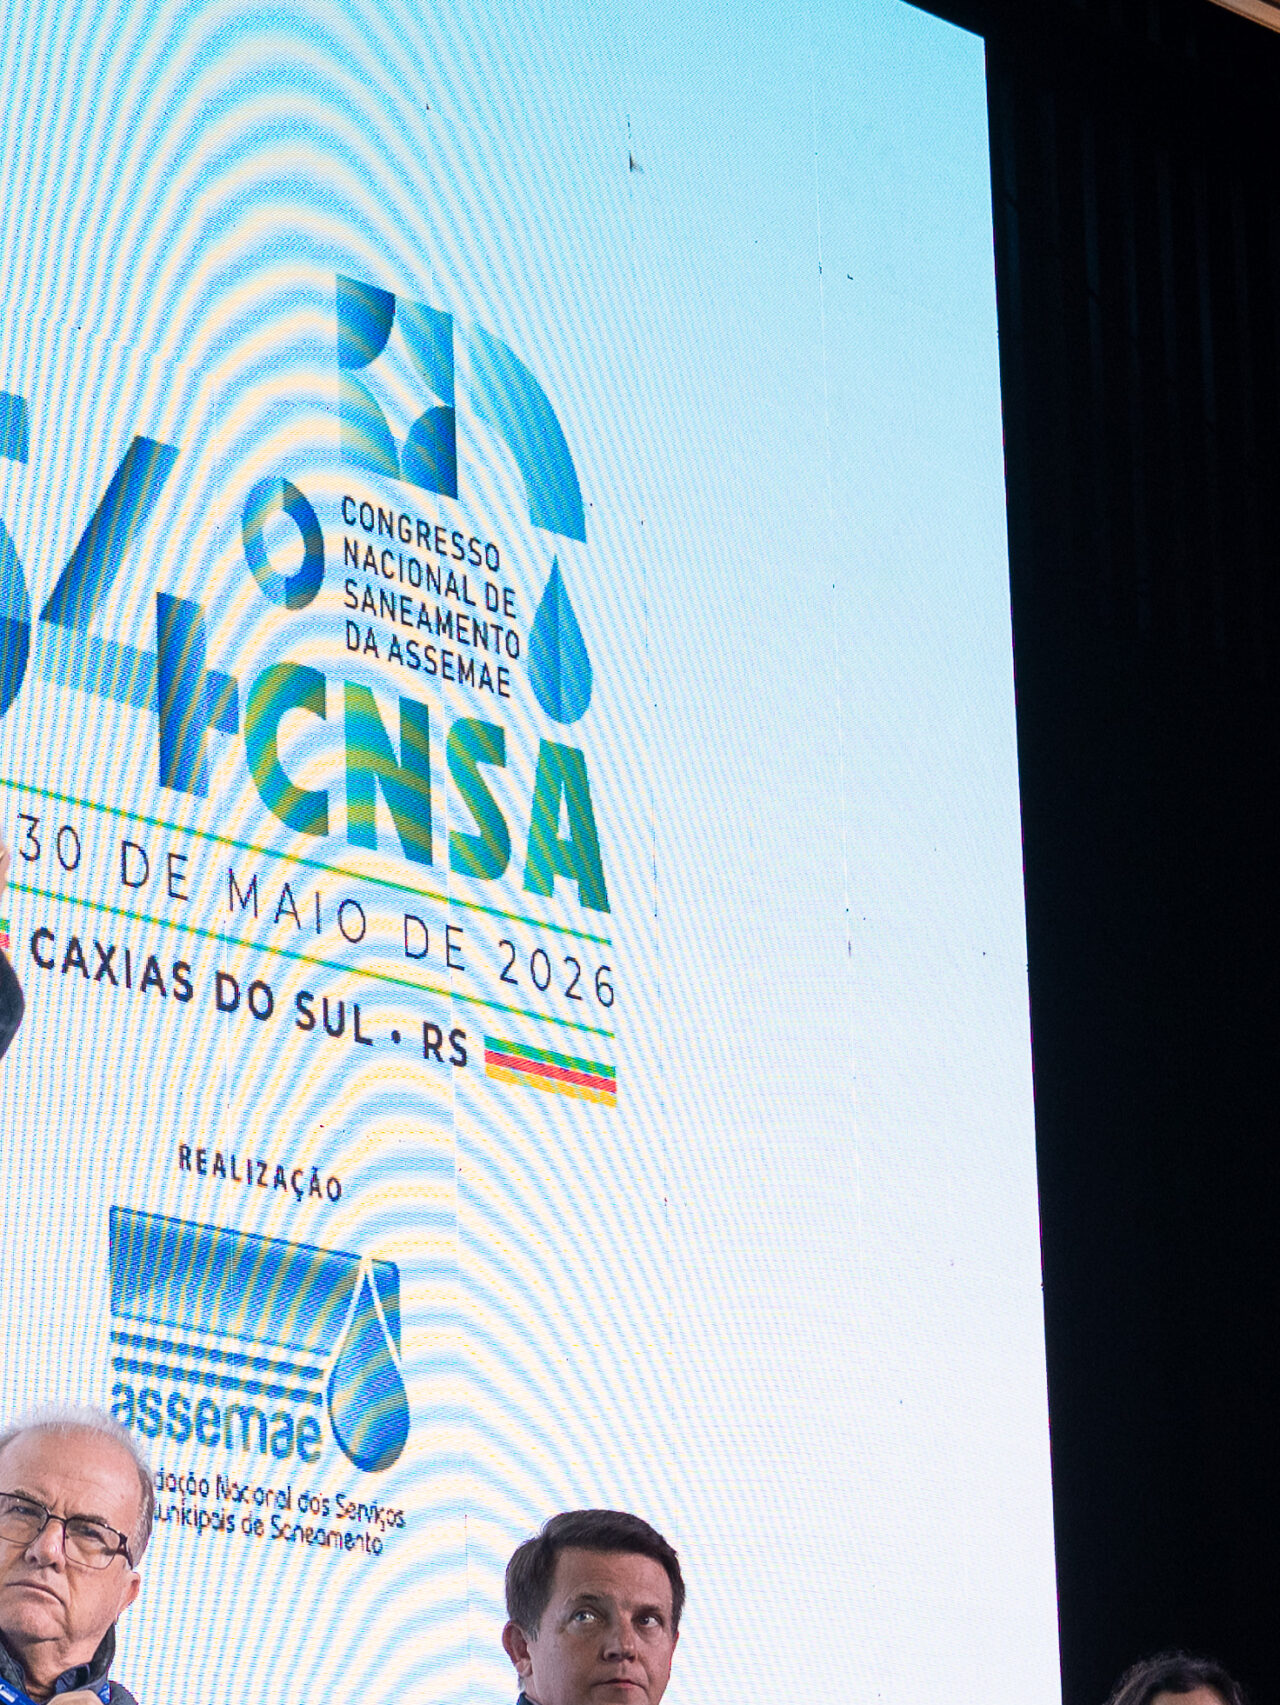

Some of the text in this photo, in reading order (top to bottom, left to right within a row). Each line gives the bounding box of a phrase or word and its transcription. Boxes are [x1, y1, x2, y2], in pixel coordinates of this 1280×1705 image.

[342, 495, 500, 573] CONGRESSO
[344, 536, 517, 619] NACIONAL DE
[344, 578, 521, 661] SANEAMENTO
[346, 619, 511, 698] DA ASSEMAE
[245, 661, 612, 914] CNSA
[17, 813, 81, 871] 30
[121, 840, 189, 901] DE
[228, 867, 367, 944] MAIO
[404, 913, 466, 972] DE
[498, 939, 614, 1008] 2026
[30, 927, 469, 1068] CAXIAS DO SUL RS
[179, 1143, 342, 1202] REALIZAÇÃO
[111, 1383, 323, 1464] assemae
[154, 1503, 384, 1556] unicipais de Saneamento
[216, 1473, 292, 1511] Nacional
[298, 1489, 330, 1517] dos
[335, 1493, 406, 1532] Serviços
